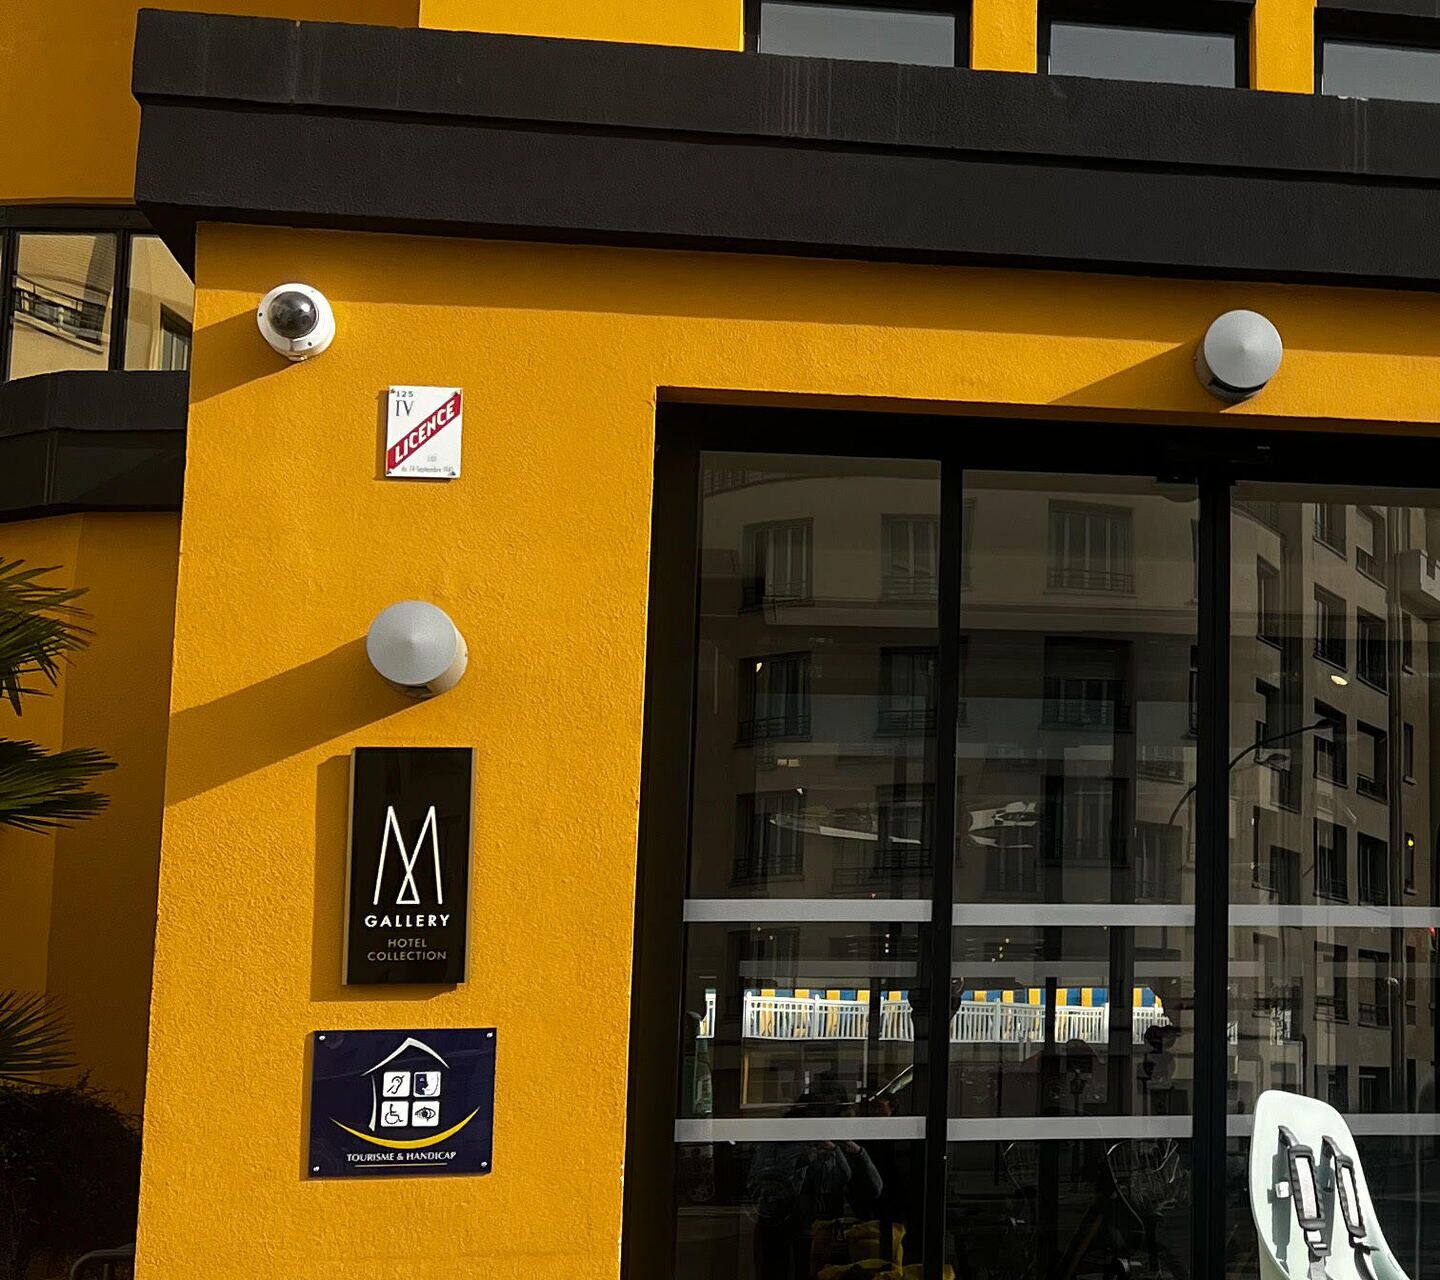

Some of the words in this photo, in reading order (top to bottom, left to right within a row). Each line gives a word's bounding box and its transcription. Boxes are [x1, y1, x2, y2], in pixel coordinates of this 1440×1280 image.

[396, 399, 414, 417] IV
[394, 400, 455, 463] LICENCE
[364, 914, 450, 928] GALLERY
[387, 938, 427, 948] HOTEL
[367, 951, 447, 961] COLLECTION
[346, 1152, 395, 1162] TOURISME
[406, 1151, 457, 1160] HANDICAP
